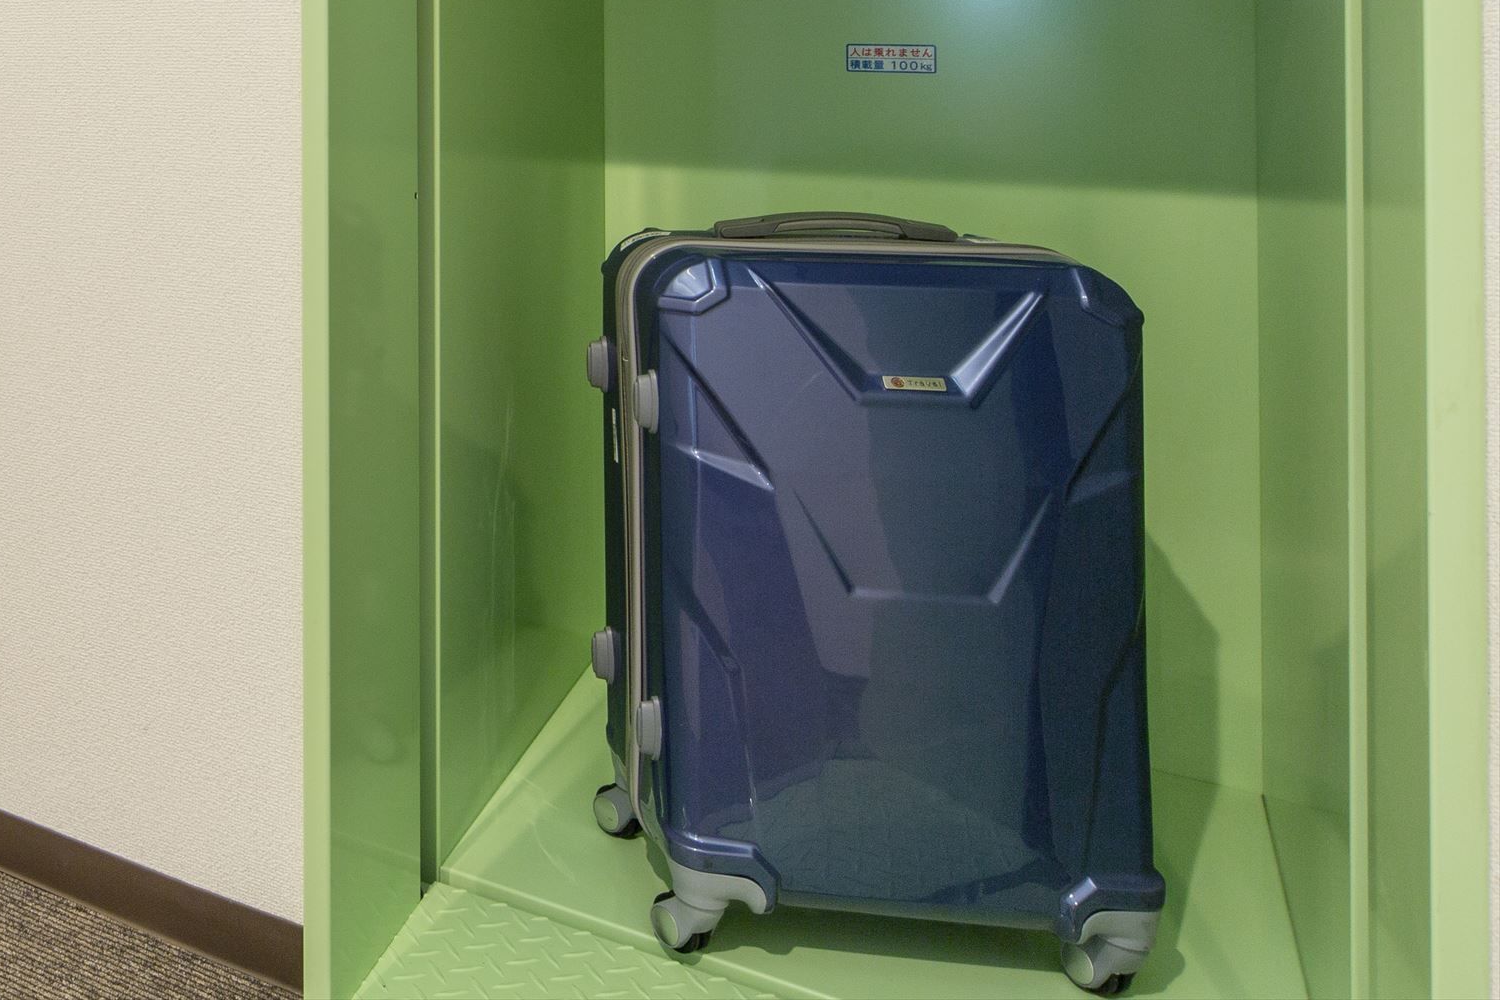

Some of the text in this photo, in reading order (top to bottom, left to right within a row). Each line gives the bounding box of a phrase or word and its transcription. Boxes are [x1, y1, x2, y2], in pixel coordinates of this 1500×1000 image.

[850, 47, 933, 58] 人は乗れません
[891, 60, 933, 72] 100kg
